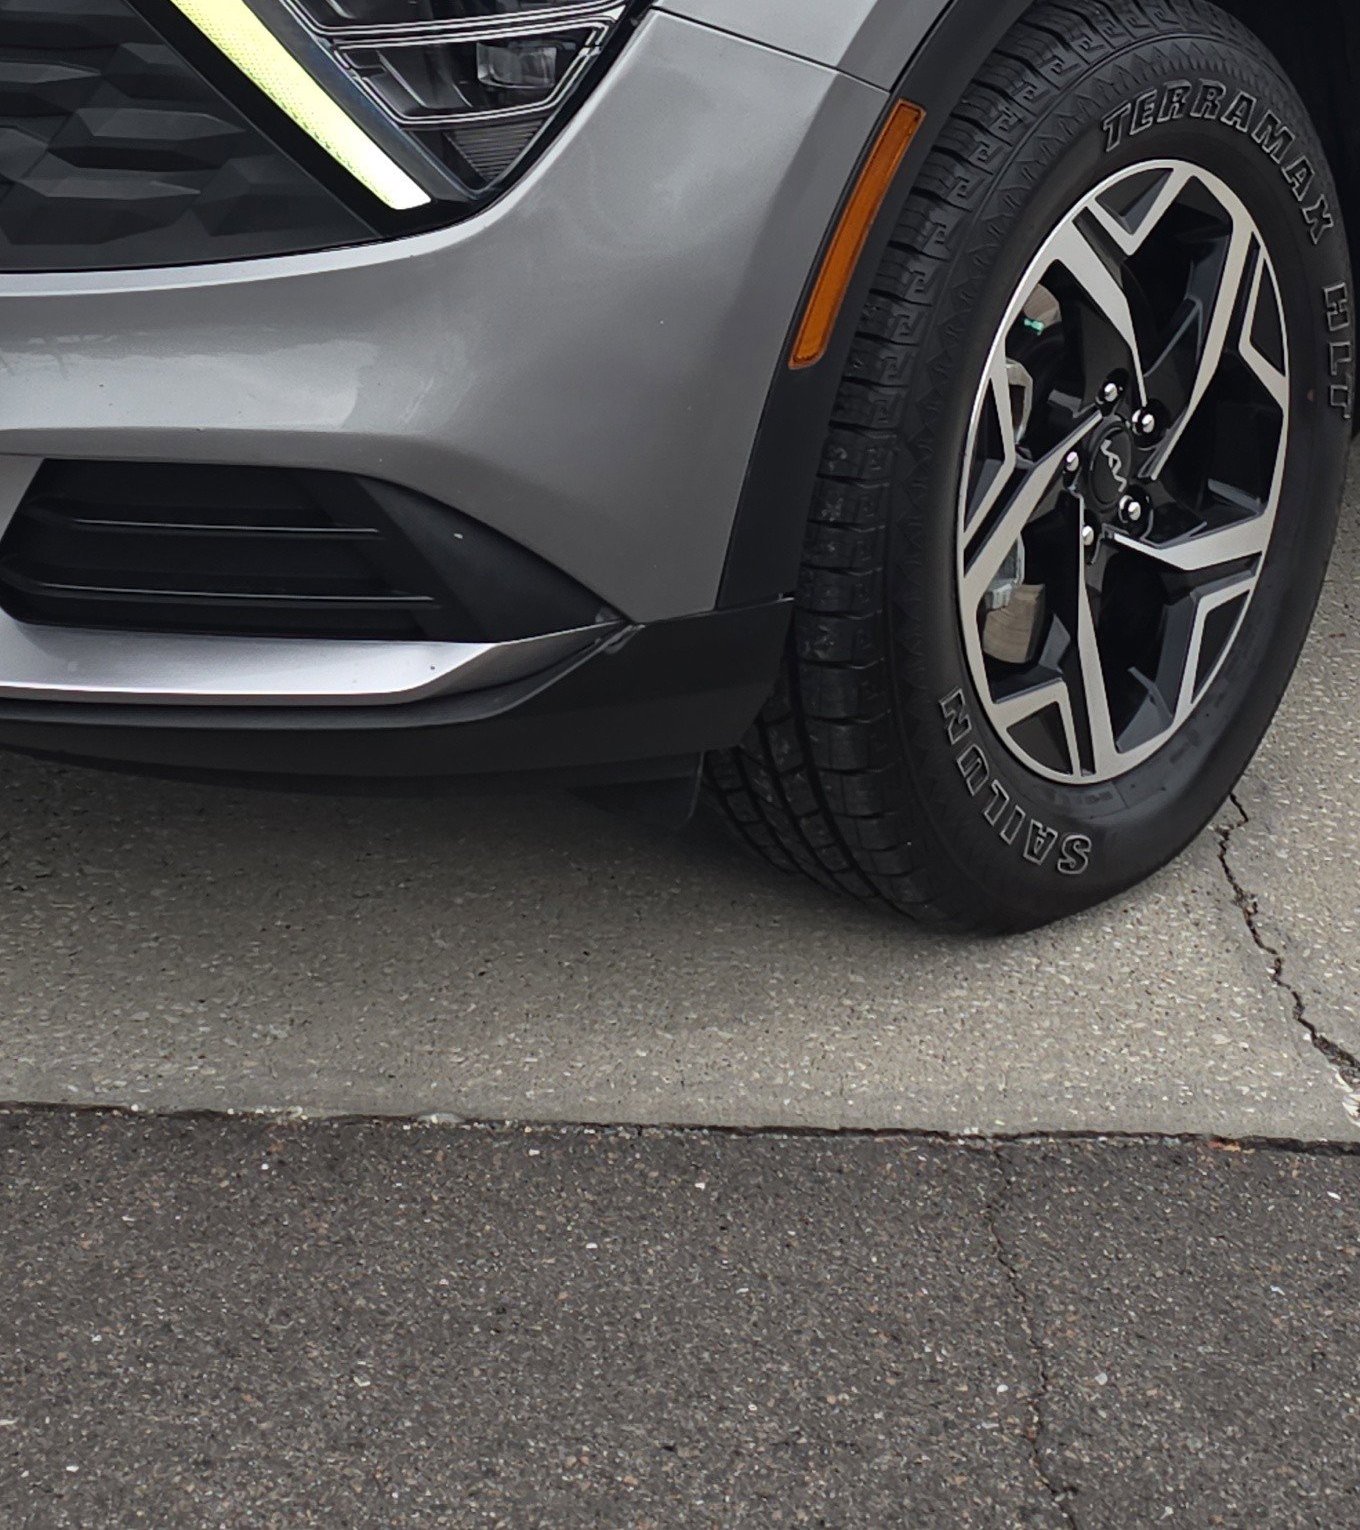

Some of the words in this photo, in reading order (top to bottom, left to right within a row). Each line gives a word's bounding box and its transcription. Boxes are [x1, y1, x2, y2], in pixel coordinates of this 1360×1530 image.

[1102, 78, 1334, 245] TERRAMAX
[1323, 282, 1351, 419] HLT
[939, 688, 1092, 875] SAILUN
